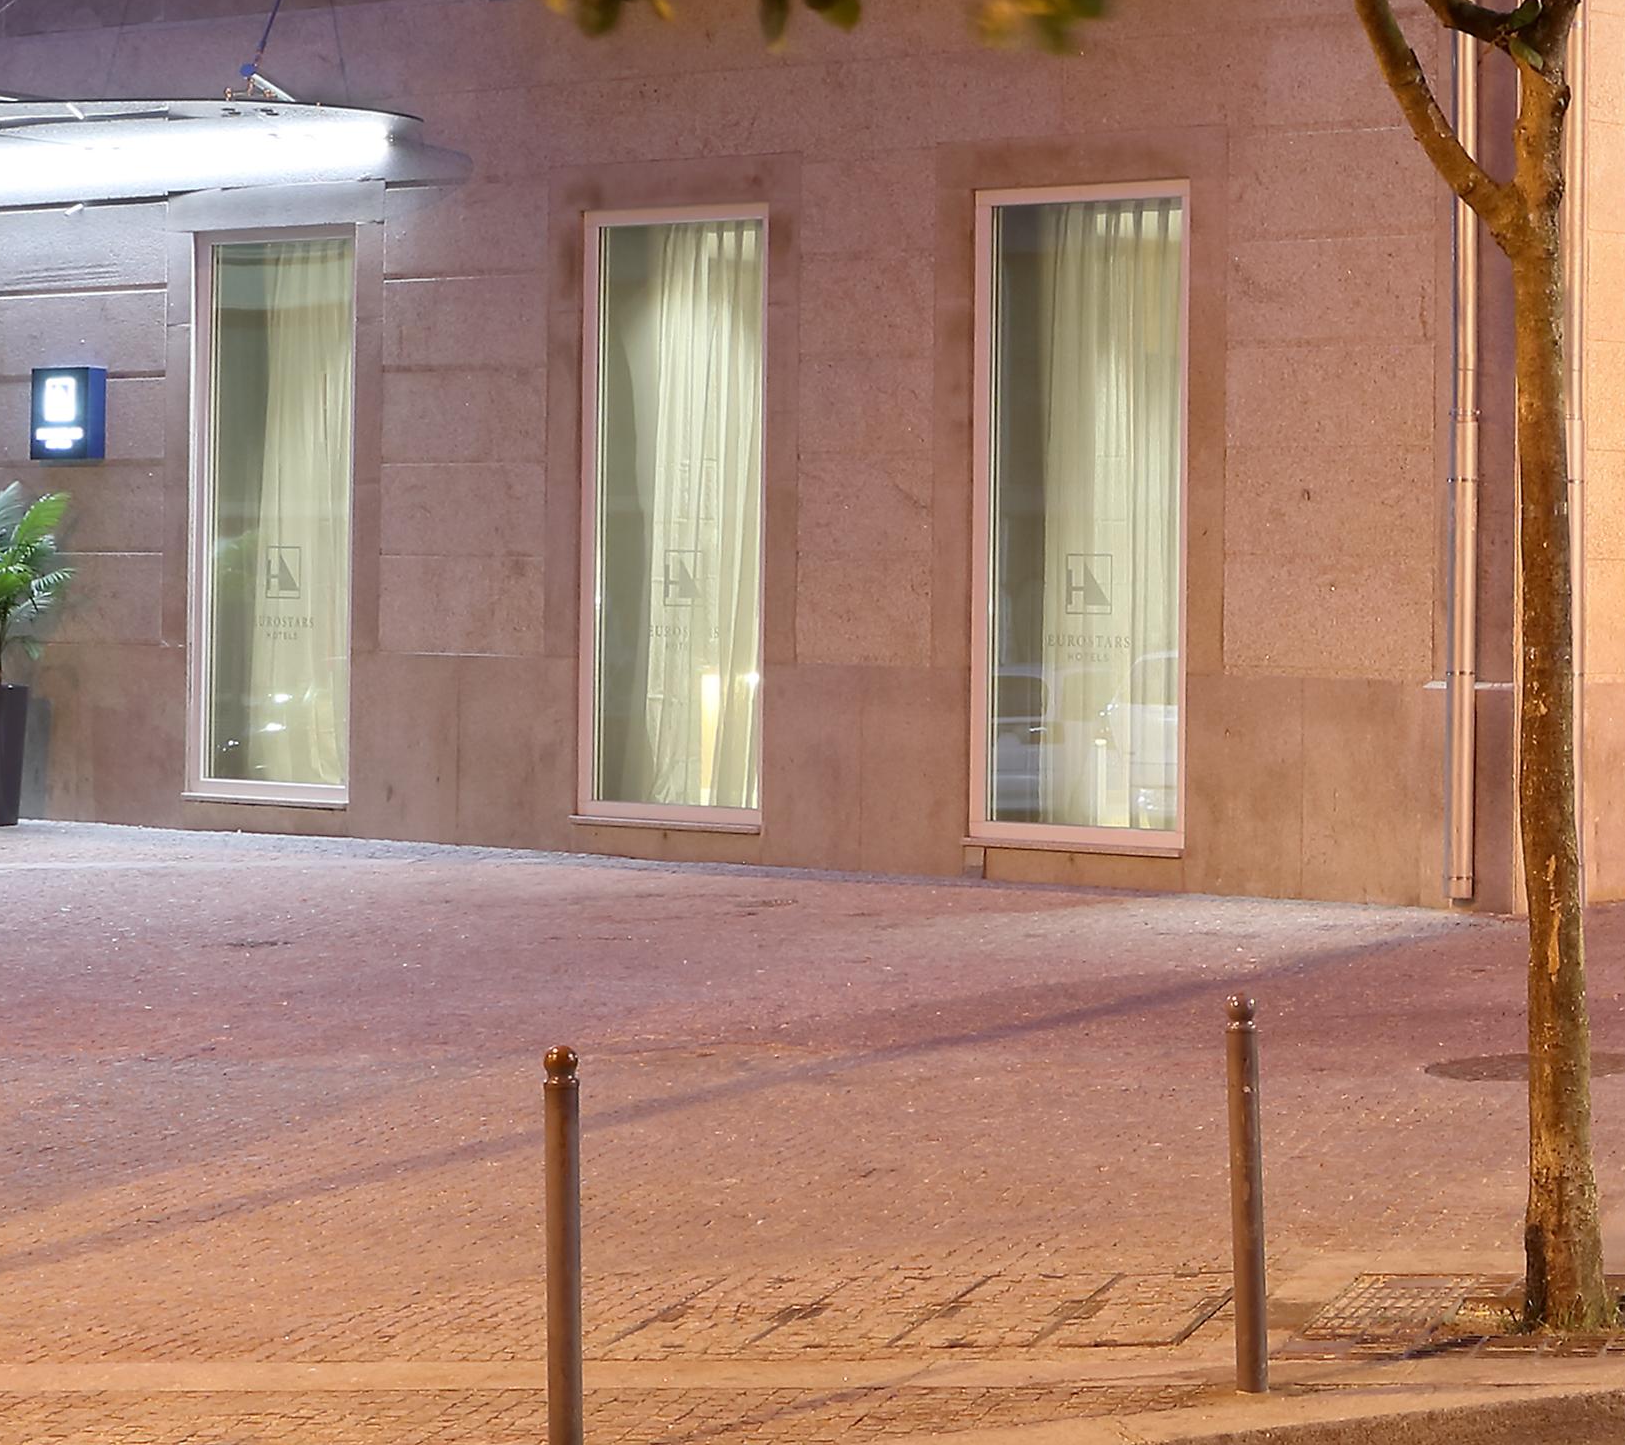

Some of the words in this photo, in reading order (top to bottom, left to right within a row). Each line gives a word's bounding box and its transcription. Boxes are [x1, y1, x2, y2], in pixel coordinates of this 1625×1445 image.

[254, 614, 315, 629] UROSTARS
[1046, 634, 1132, 649] EUROSTARS
[1067, 651, 1111, 663] HOTELS
